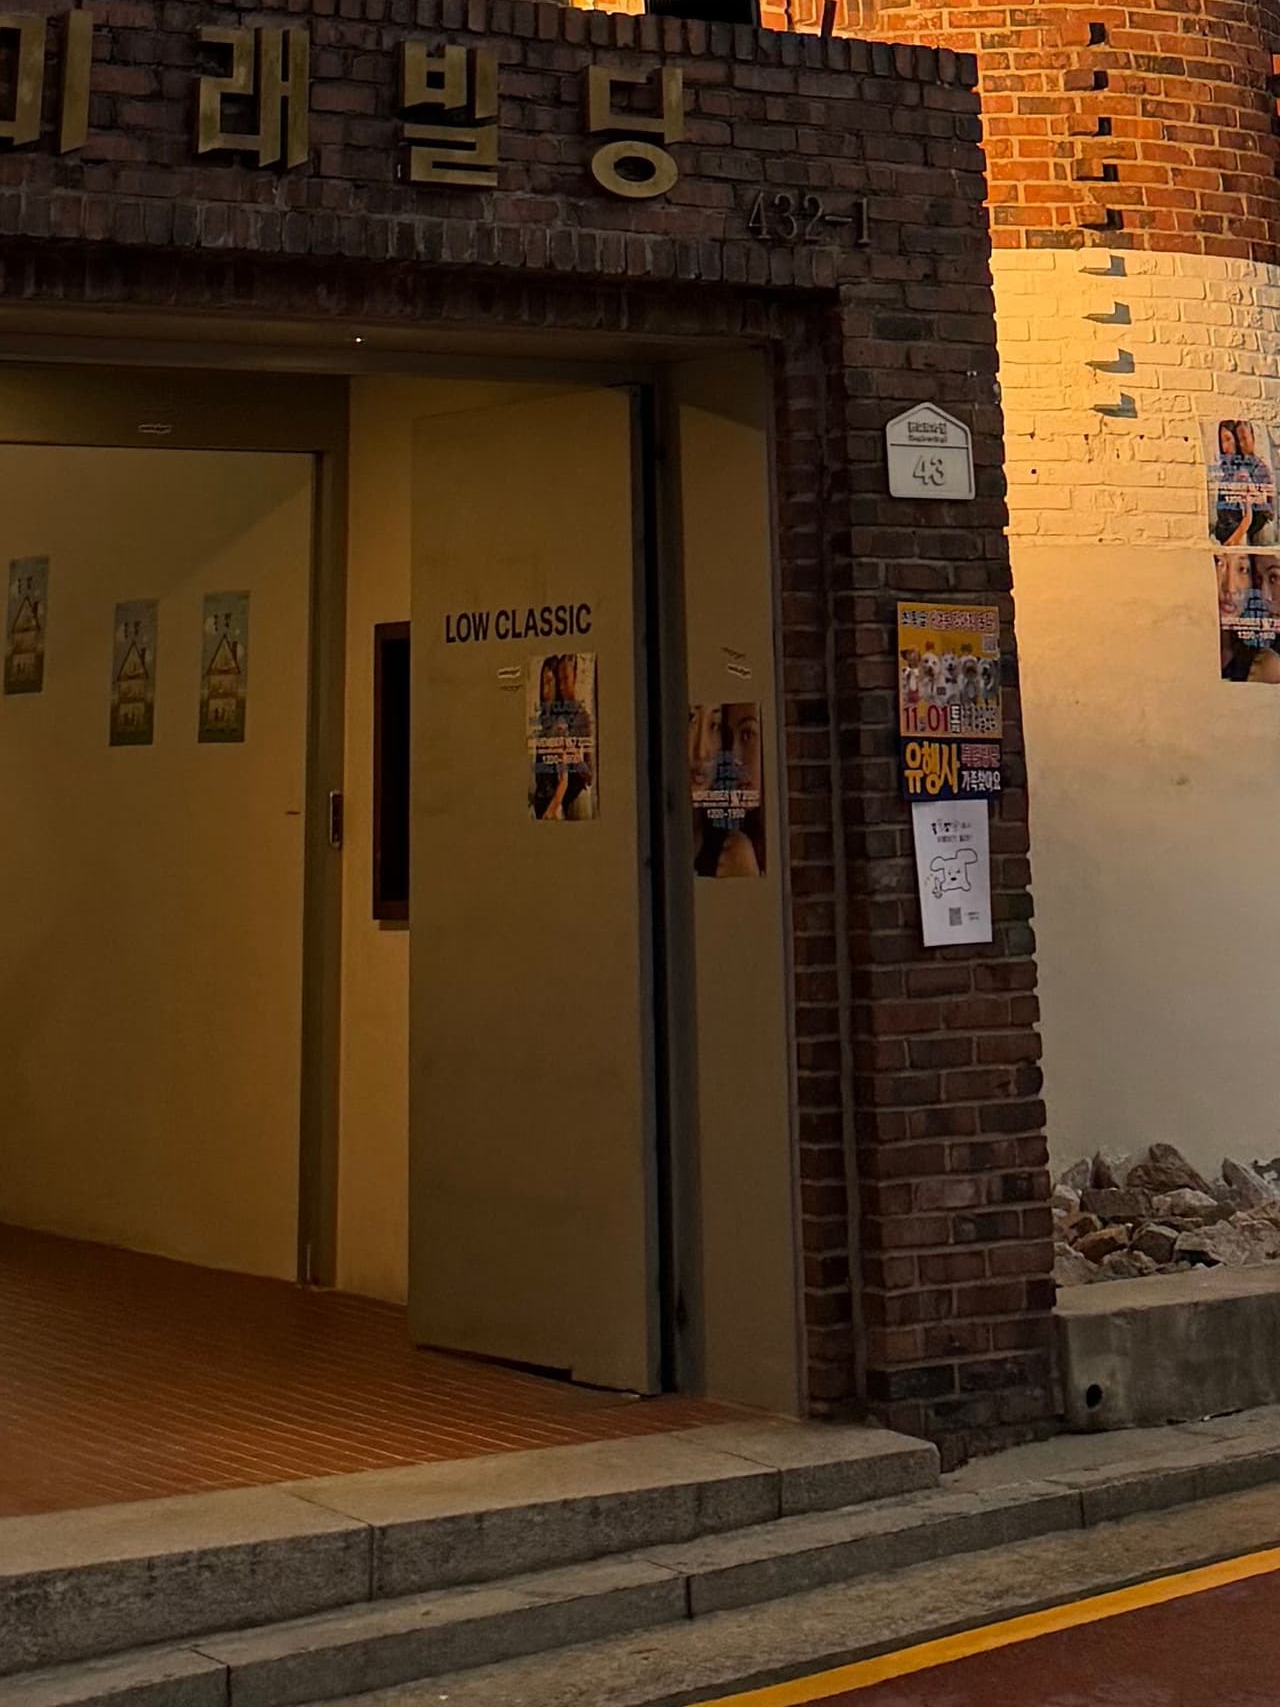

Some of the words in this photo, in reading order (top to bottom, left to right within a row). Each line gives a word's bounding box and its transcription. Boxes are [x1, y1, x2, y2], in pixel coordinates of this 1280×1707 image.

[747, 191, 871, 244] 432-1
[911, 455, 945, 486] 43
[445, 611, 490, 643] LOW
[495, 603, 592, 640] CLASSIC
